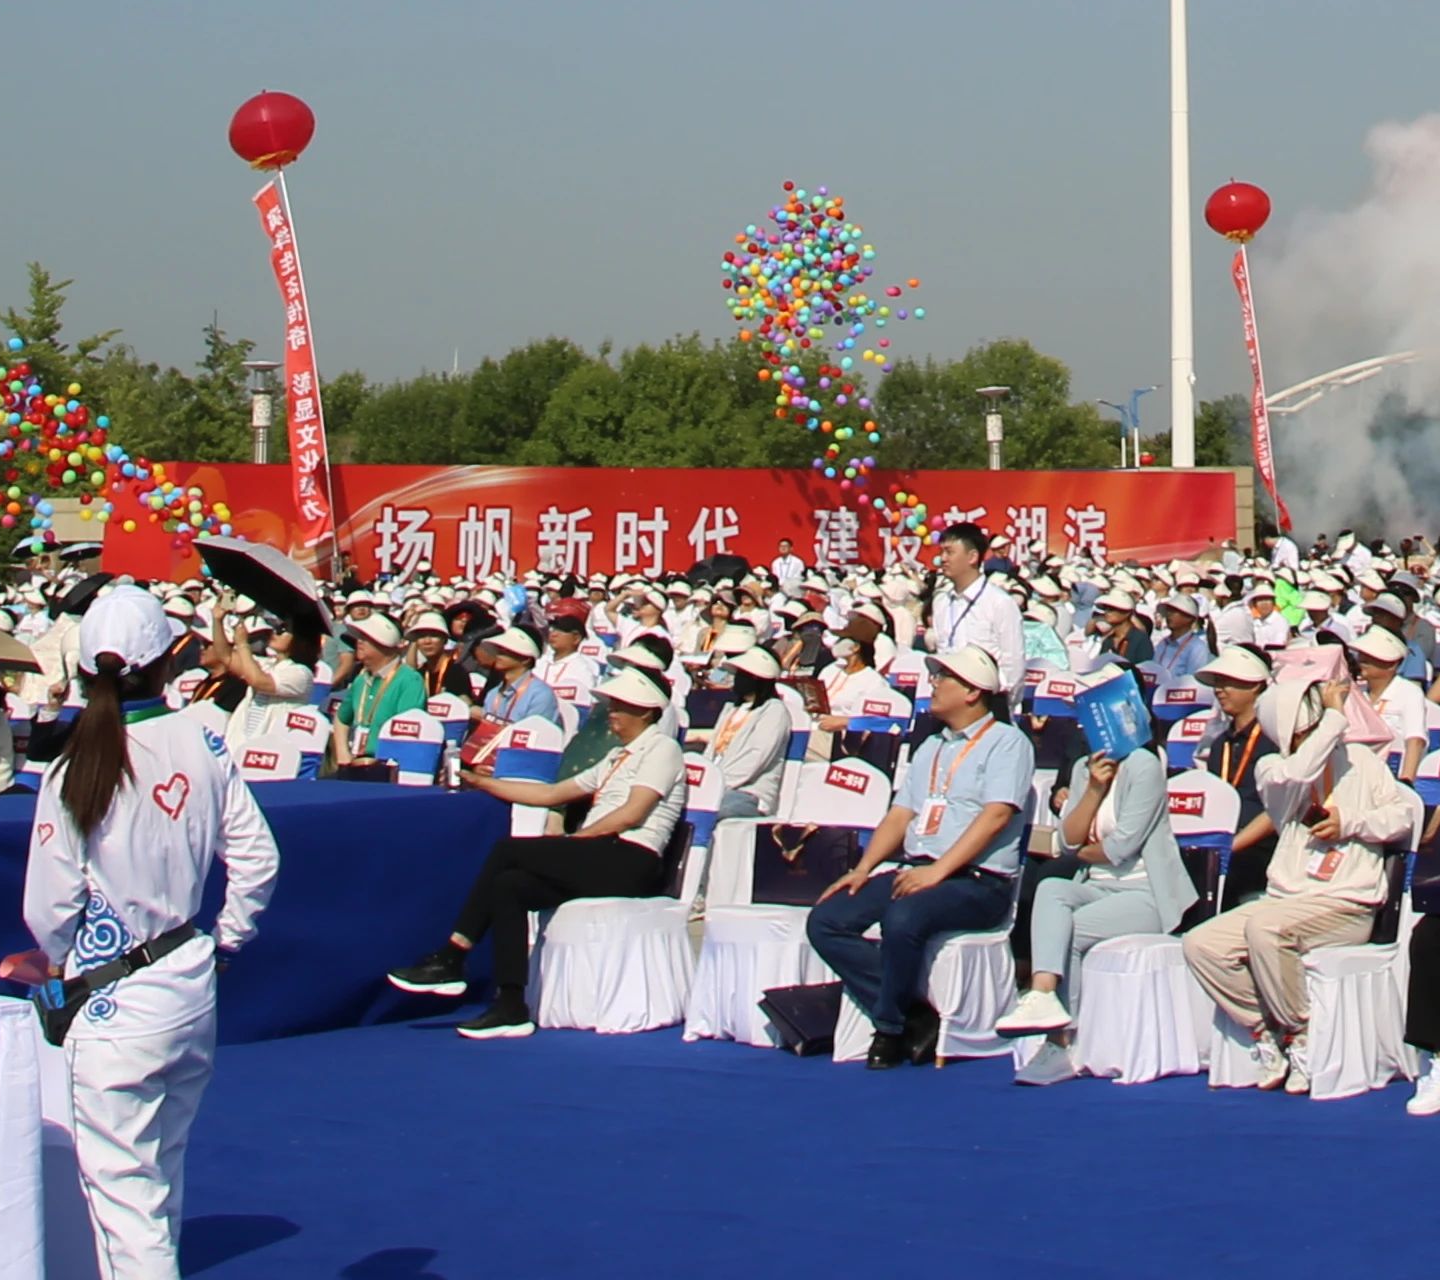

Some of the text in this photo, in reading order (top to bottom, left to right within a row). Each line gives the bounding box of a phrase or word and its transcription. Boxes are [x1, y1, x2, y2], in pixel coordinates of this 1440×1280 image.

[373, 503, 741, 584] 扬帆新时代
